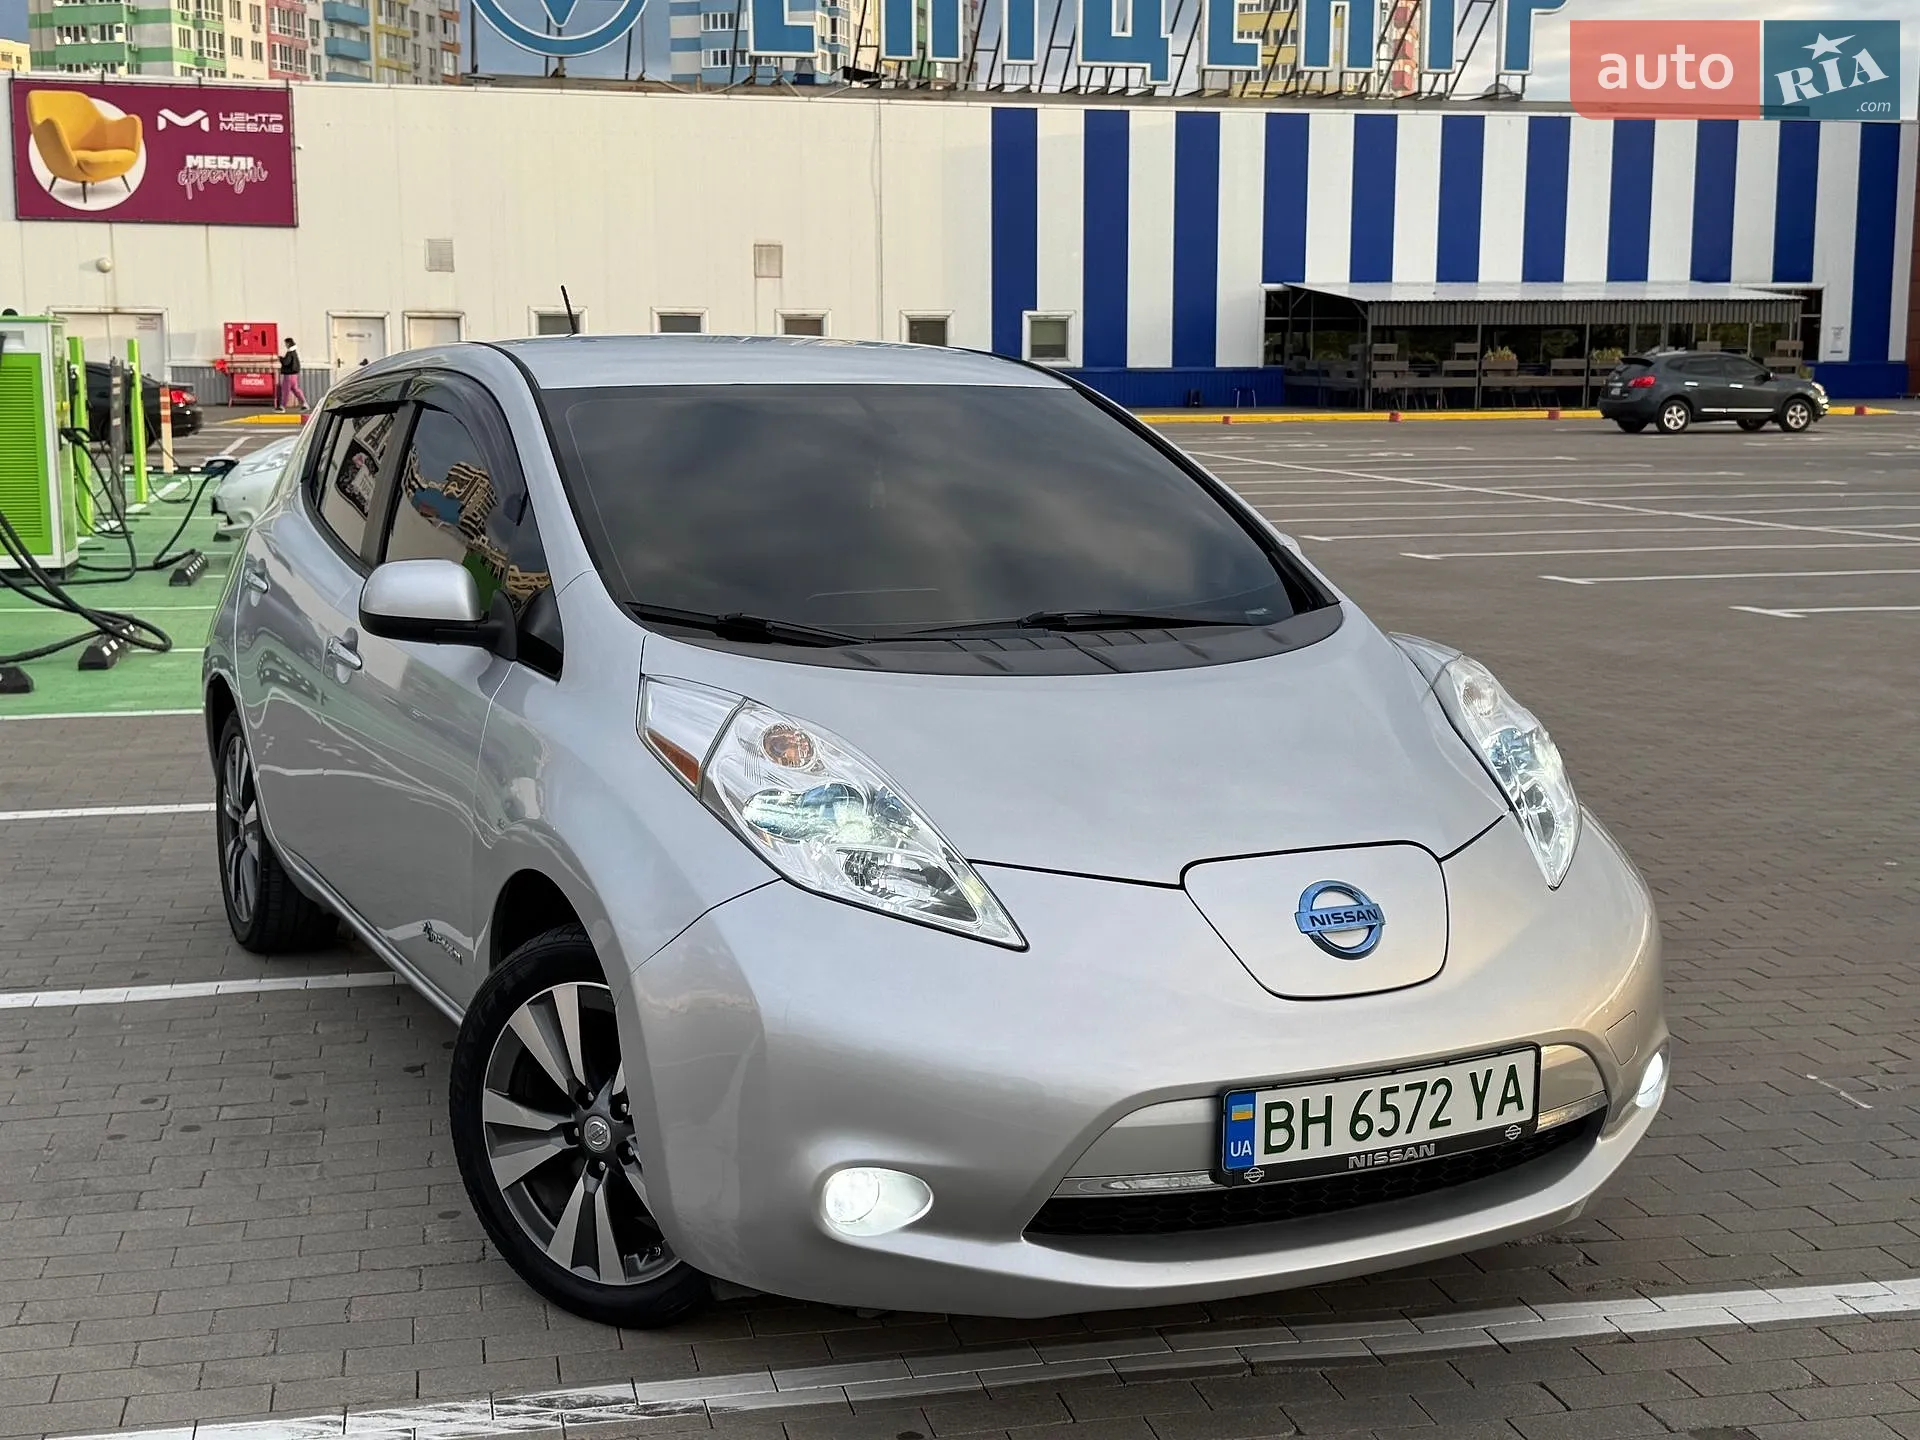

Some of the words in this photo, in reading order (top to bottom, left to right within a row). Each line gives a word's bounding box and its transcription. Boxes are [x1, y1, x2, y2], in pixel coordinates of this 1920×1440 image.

[219, 112, 283, 123] ЦЕНТР
[185, 155, 254, 170] МЕБЛІ
[1309, 908, 1379, 927] NISSAN
[1263, 1095, 1333, 1155] BH
[1349, 1077, 1452, 1142] 6572
[1469, 1064, 1525, 1121] YA
[1230, 1139, 1253, 1157] UA
[1348, 1143, 1435, 1170] NISSAN
